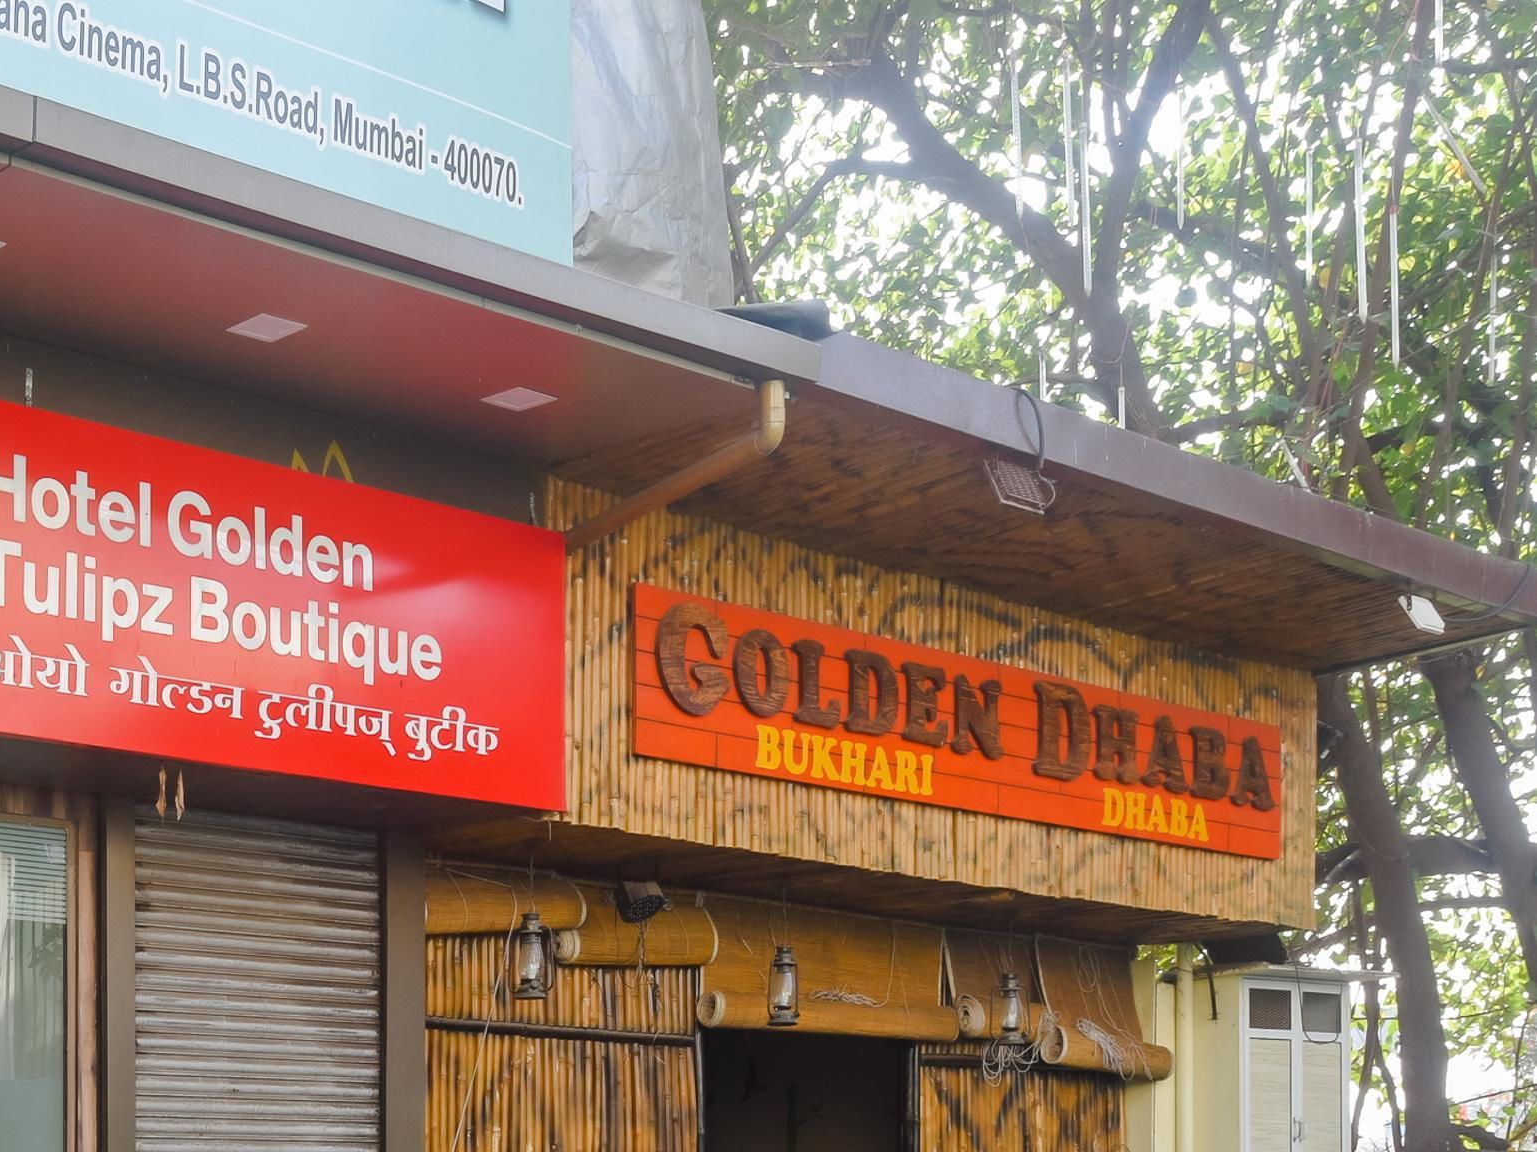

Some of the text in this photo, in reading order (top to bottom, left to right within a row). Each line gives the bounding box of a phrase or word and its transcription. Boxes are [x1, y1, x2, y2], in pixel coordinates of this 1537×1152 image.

[57, 3, 168, 93] Cinema,
[178, 44, 325, 147] L.B.S.Road,
[333, 101, 424, 168] Mumbai
[443, 143, 524, 205] 400070.
[167, 491, 374, 591] Golden
[190, 576, 443, 684] Boutique
[109, 656, 244, 719] गोल्डन
[404, 706, 500, 761] बुटीक
[656, 602, 1276, 810] GOLDEN DHABA
[755, 724, 935, 797] BUKHARI
[1103, 787, 1209, 843] DHABA
